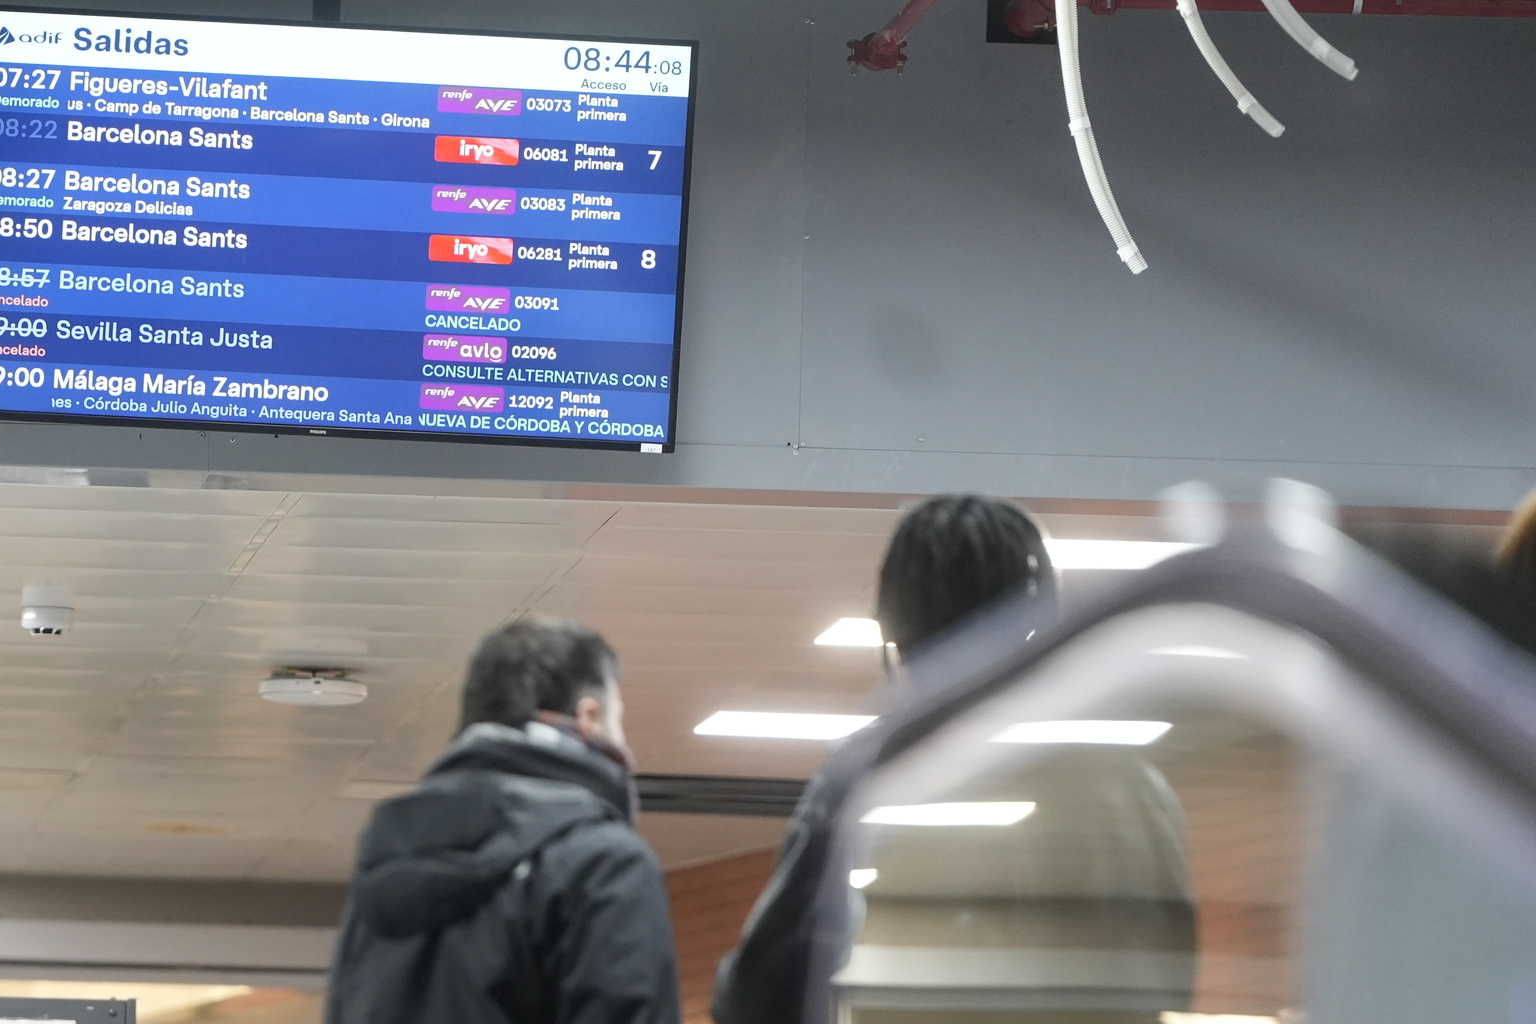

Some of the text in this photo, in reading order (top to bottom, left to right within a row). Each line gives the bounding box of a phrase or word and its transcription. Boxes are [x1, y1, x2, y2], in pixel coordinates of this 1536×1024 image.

[18, 30, 64, 45] adif
[72, 26, 189, 56] Salidas
[564, 46, 682, 76] 08:44:08
[69, 70, 268, 101] Figueres-Vilafant
[580, 78, 627, 92] Acceso
[649, 80, 668, 94] Vía
[442, 89, 473, 102] renfe
[578, 94, 619, 108] Planta
[474, 98, 572, 112] AVE 03073
[94, 98, 139, 116] Camp
[142, 100, 162, 114] de
[164, 102, 238, 120] Tarragona
[250, 106, 324, 123] Barcelona
[328, 110, 370, 126] Sants
[380, 112, 430, 128] Girona
[576, 108, 626, 122] primera
[67, 120, 183, 146] Barcelona
[188, 126, 253, 150] Sants
[459, 140, 568, 162] iryo 06081
[574, 144, 616, 157] Planta
[574, 158, 624, 172] primera
[648, 150, 662, 170] 7
[64, 170, 180, 196] Barcelona
[186, 176, 250, 200] Sants
[436, 188, 467, 201] renfe
[572, 193, 612, 207] Planta
[62, 196, 194, 216] Zaragoza Delicias
[468, 197, 566, 212] AVE 03083
[570, 207, 621, 221] primera
[61, 220, 177, 246] Barcelona
[182, 226, 248, 249] Sants
[453, 238, 562, 262] iryo 06281
[569, 242, 610, 256] Planta
[568, 256, 618, 270] primera
[640, 250, 656, 269] 8
[59, 270, 174, 295] Barcelona
[180, 276, 244, 298] Sants
[430, 287, 461, 300] renfe
[463, 296, 560, 311] AVE 03091
[425, 314, 521, 332] CANCELADO
[56, 320, 132, 343] Sevilla
[138, 324, 203, 346] Santa
[210, 328, 274, 350] Justa
[428, 336, 458, 350] renfe
[460, 342, 556, 362] avlo 02096
[422, 364, 504, 382] CONSULTE
[506, 367, 618, 386] ALTERNATIVAS
[622, 374, 656, 388] CON
[52, 369, 136, 397] Málaga
[142, 373, 206, 396] María
[212, 377, 328, 402] Zambrano
[425, 386, 455, 398] renfe
[457, 394, 554, 410] AVE 12092
[560, 390, 601, 404] Planta
[84, 396, 148, 412] Córdoba
[151, 400, 187, 415] Julio
[190, 403, 248, 419] Anguita
[258, 406, 335, 423] Antequera
[338, 409, 381, 424] Santa
[384, 412, 413, 426] Ana
[559, 404, 608, 418] primera
[470, 416, 492, 430] DE
[494, 414, 570, 433] CÓRDOBA
[574, 420, 584, 434] Y
[588, 418, 664, 438] CÓRDOBA
